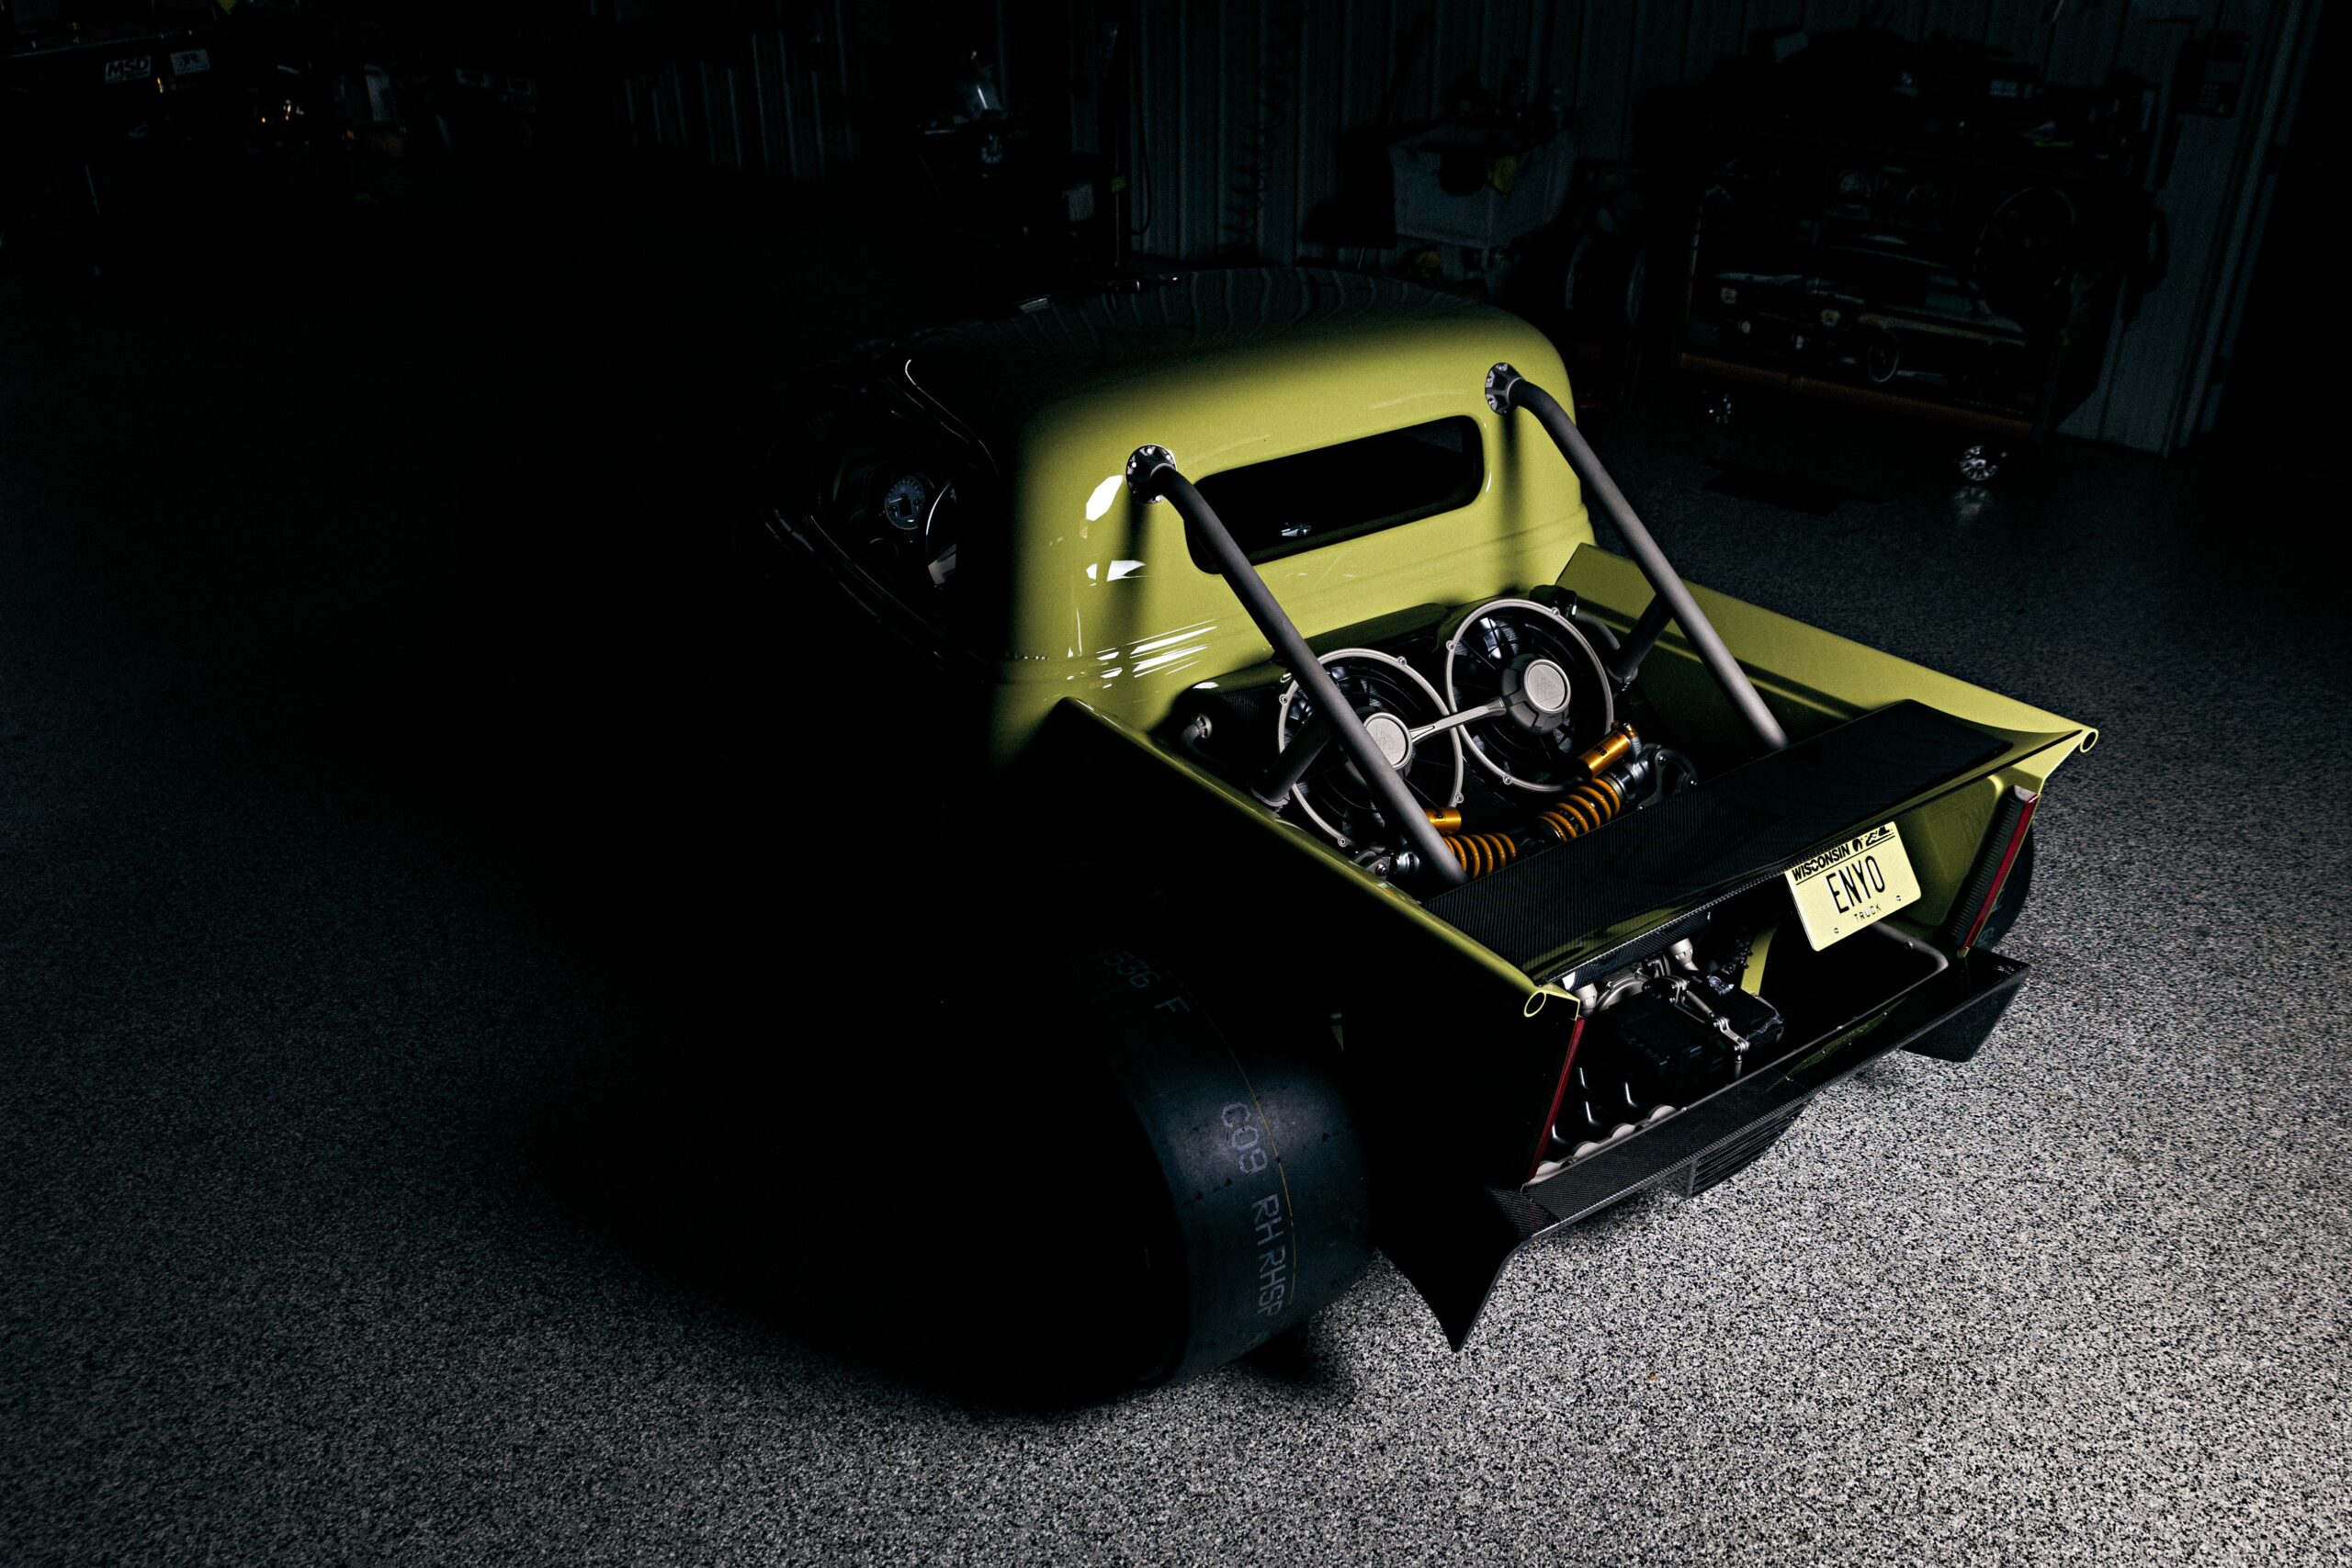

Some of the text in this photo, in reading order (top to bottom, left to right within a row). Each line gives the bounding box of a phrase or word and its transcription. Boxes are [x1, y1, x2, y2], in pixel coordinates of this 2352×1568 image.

[107, 57, 149, 77] MSD
[1792, 843, 1850, 882] WISCONSIN
[1826, 855, 1885, 914] ENYO
[1854, 903, 1882, 923] TRUCK
[1153, 996, 1192, 1014] F
[1221, 1102, 1287, 1318] C09 RH RHSP
